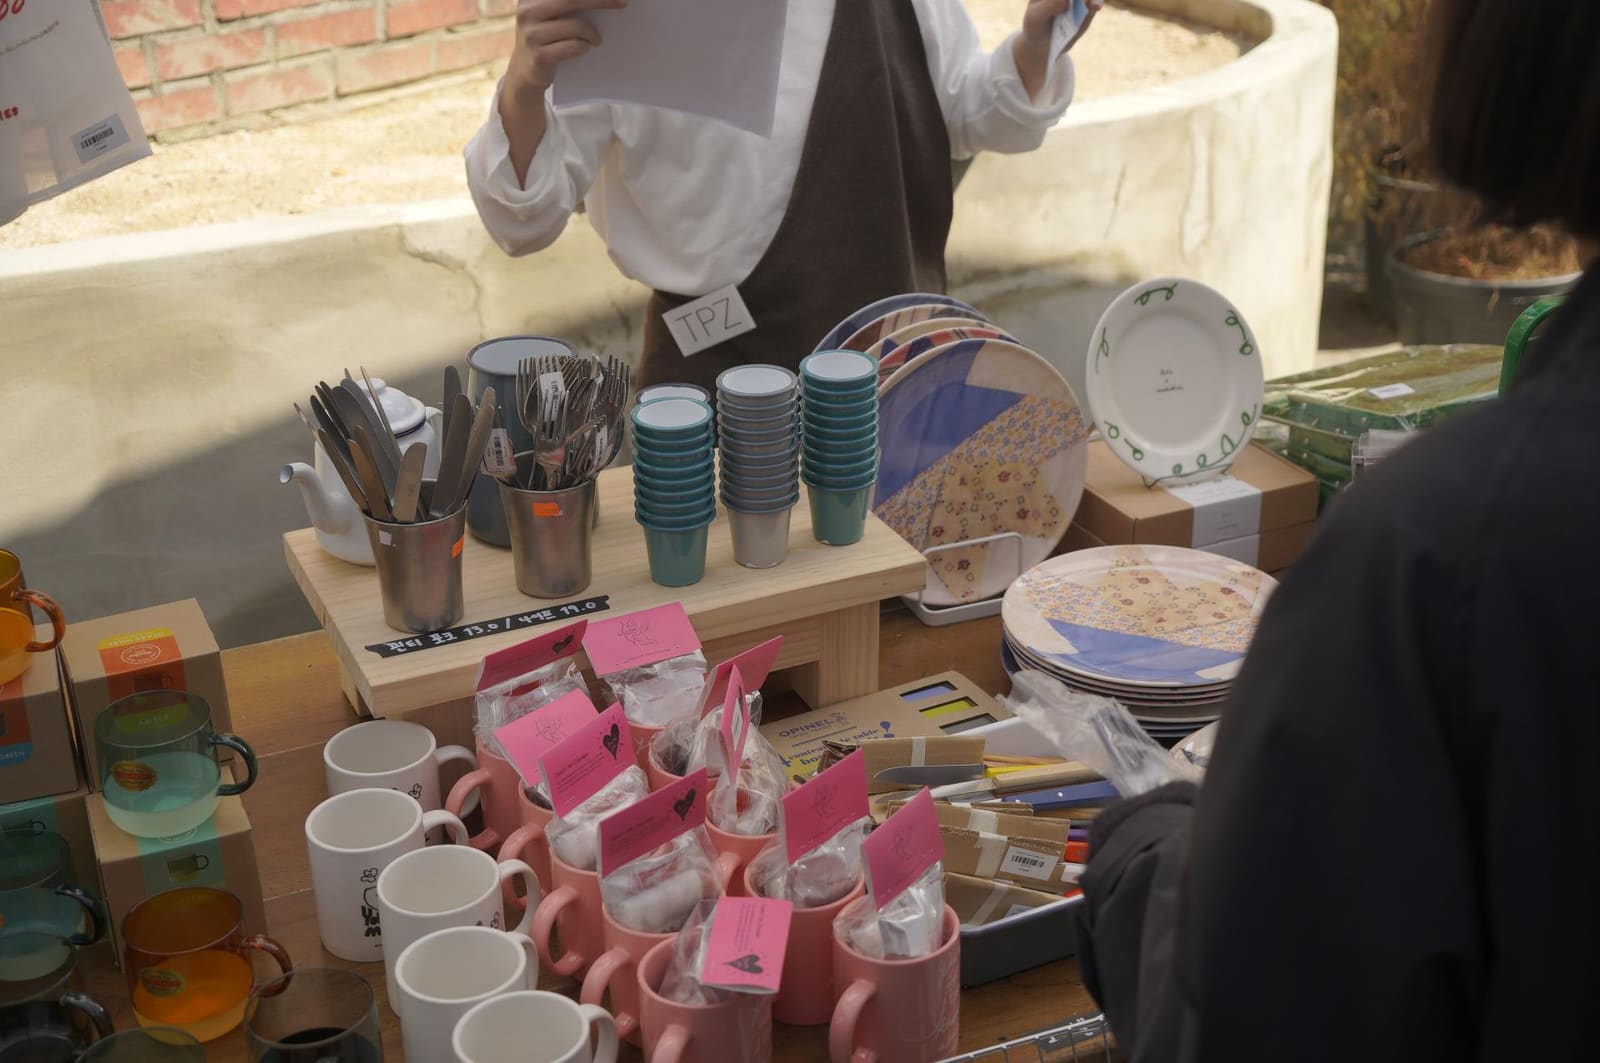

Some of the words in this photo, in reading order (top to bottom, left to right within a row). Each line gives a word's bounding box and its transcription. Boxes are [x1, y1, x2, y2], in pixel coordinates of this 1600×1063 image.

[675, 297, 743, 342] TPZ
[429, 632, 458, 645] 포크
[462, 623, 499, 637] 13.0
[559, 601, 597, 615] 19.0
[778, 718, 835, 738] OPINEL
